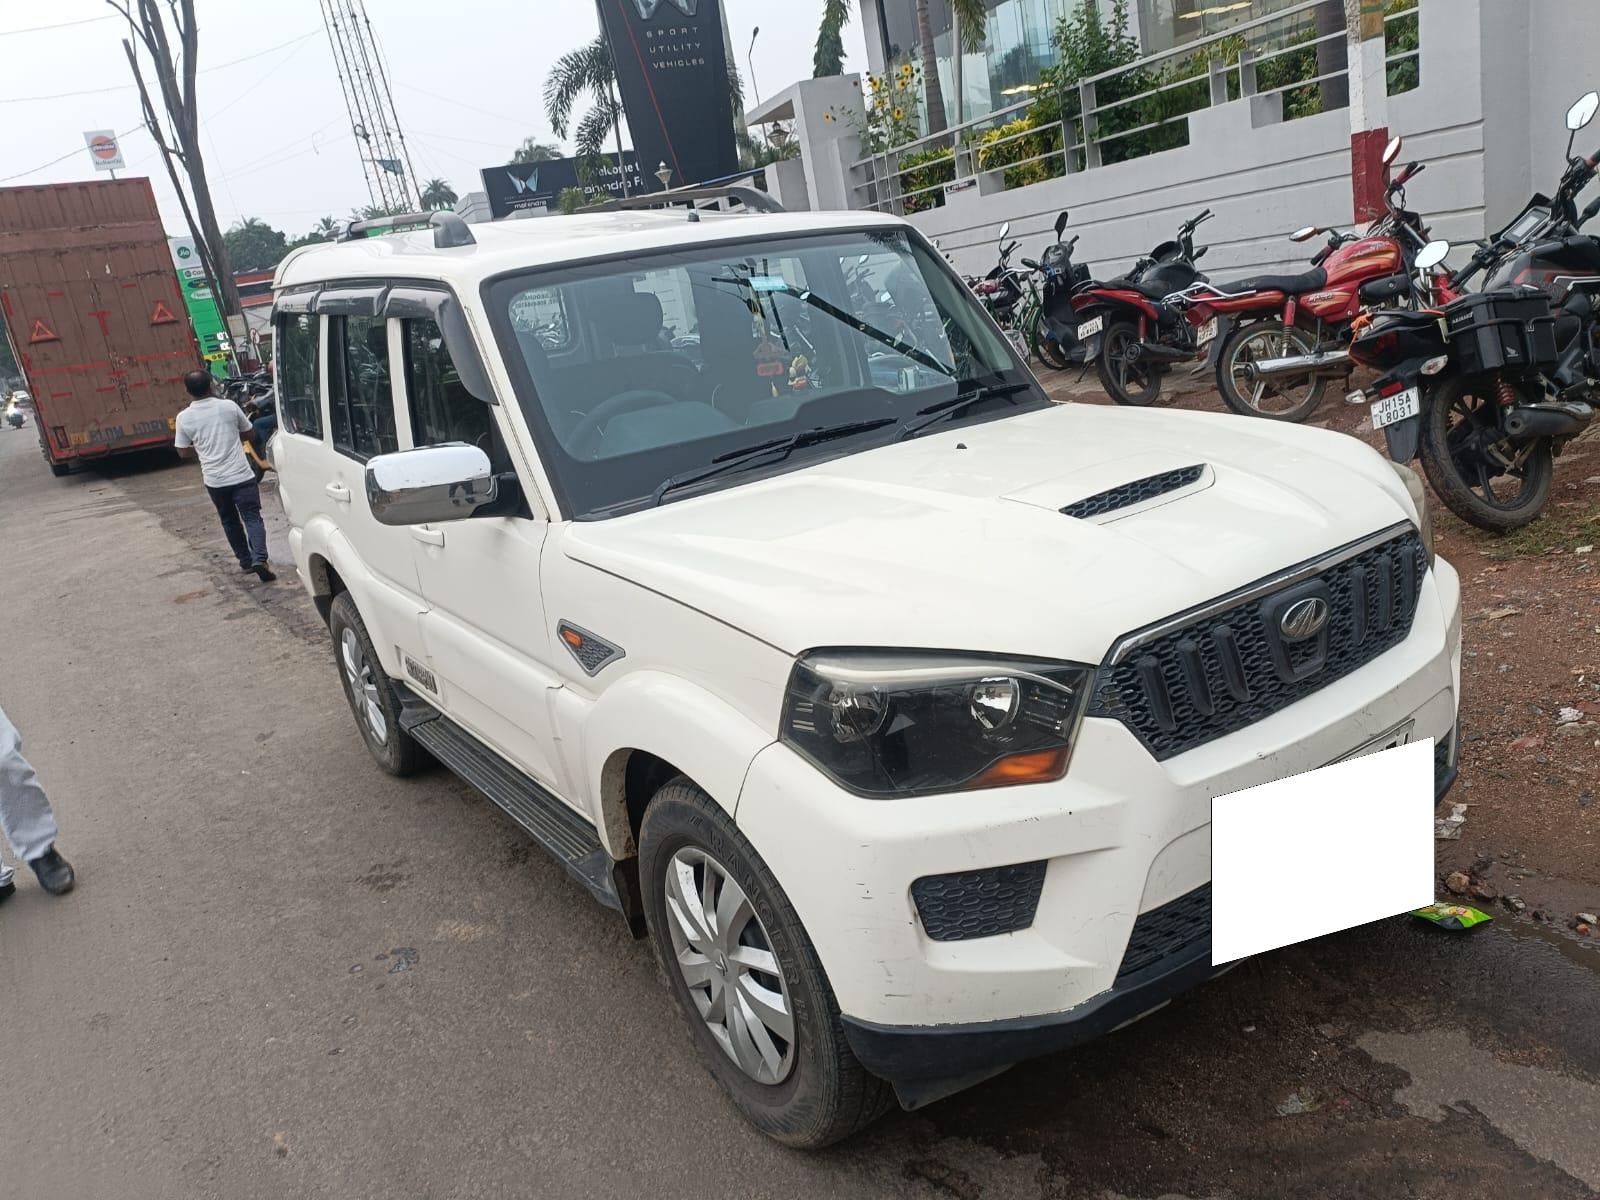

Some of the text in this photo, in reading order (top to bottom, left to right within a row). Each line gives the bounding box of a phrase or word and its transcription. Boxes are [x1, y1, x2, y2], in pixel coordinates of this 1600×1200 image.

[646, 26, 698, 38] SPORT
[649, 42, 701, 53] UTILITY
[652, 58, 705, 69] VEHICLES
[1379, 392, 1411, 414] JH15A
[1380, 403, 1412, 426] L8031
